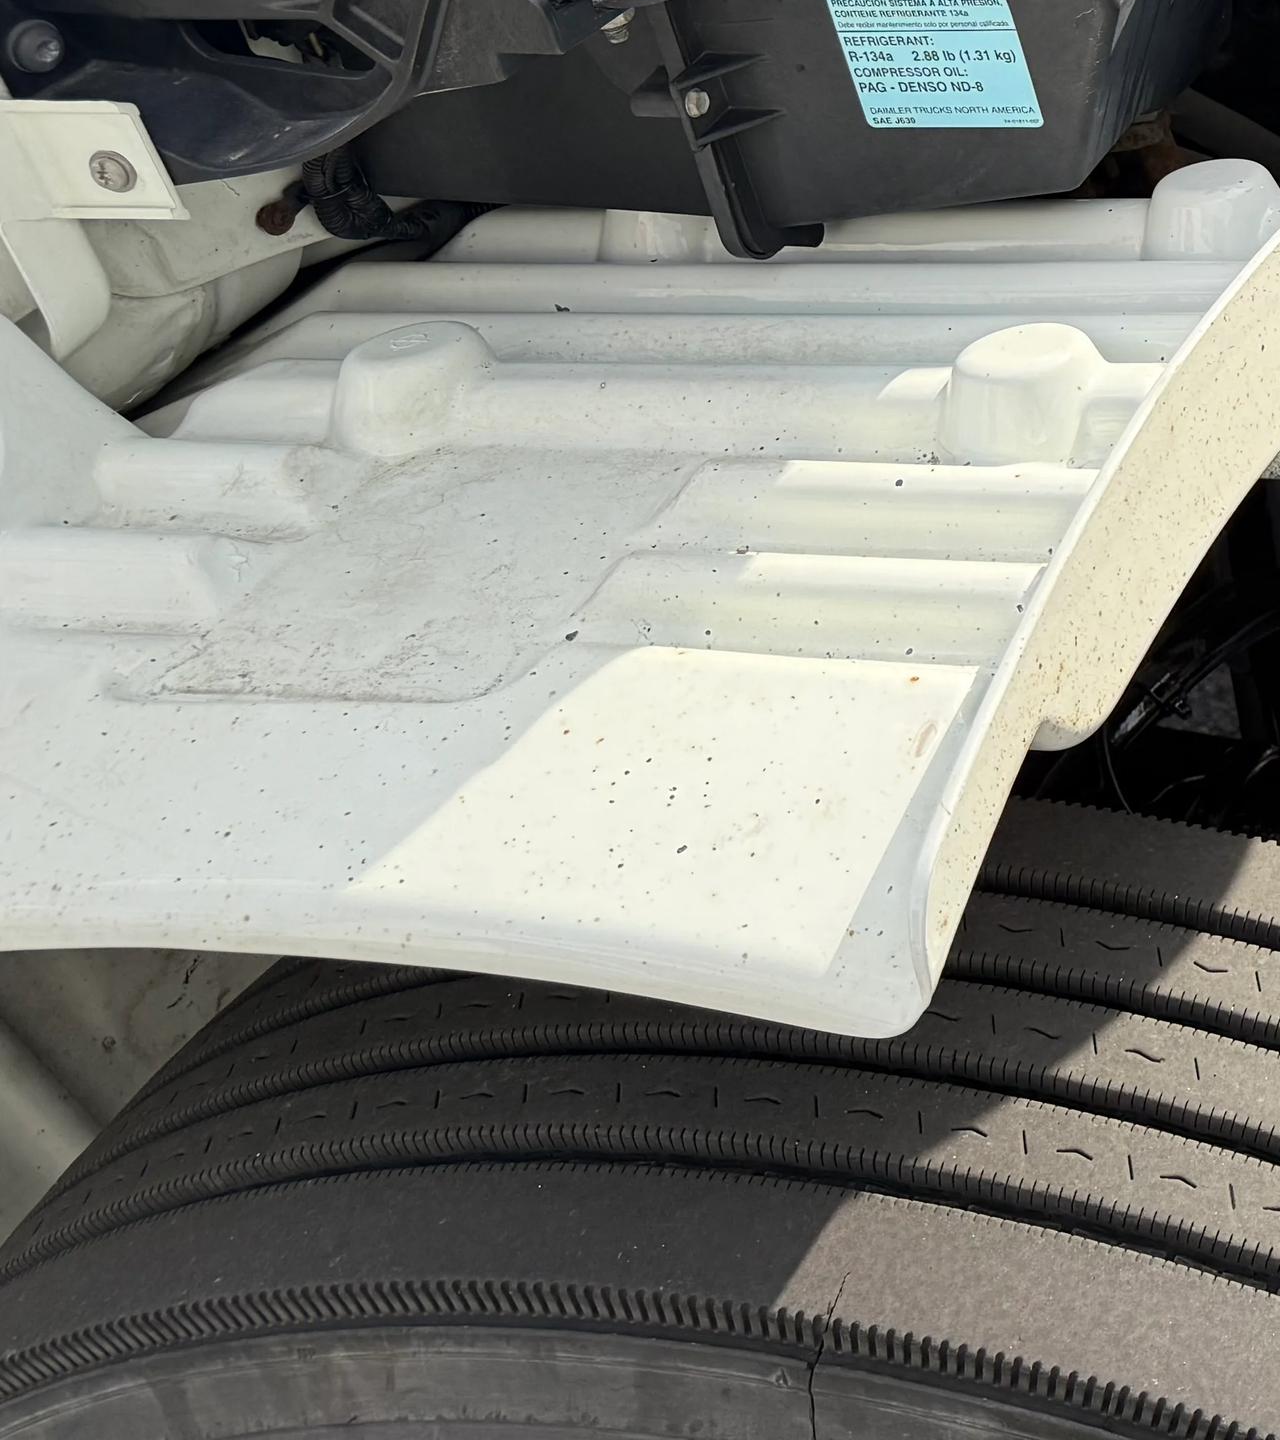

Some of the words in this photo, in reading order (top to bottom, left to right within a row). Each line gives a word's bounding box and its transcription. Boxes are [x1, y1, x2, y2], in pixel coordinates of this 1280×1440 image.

[889, 0, 927, 7] SISTEMA
[835, 10, 878, 18] CONTIENE
[950, 9, 968, 17] 134a
[844, 36, 934, 46] REFRIGERANT:
[849, 51, 893, 62] R-134a
[912, 51, 939, 62] 2.88
[943, 51, 955, 61] lb
[959, 50, 990, 64] (1.31
[996, 50, 1016, 64] kg)
[854, 68, 941, 78] COMPRESSOR
[943, 68, 968, 77] OIL:
[859, 82, 887, 93] PAG
[900, 81, 947, 92] DENSO
[952, 81, 984, 92] ND-8
